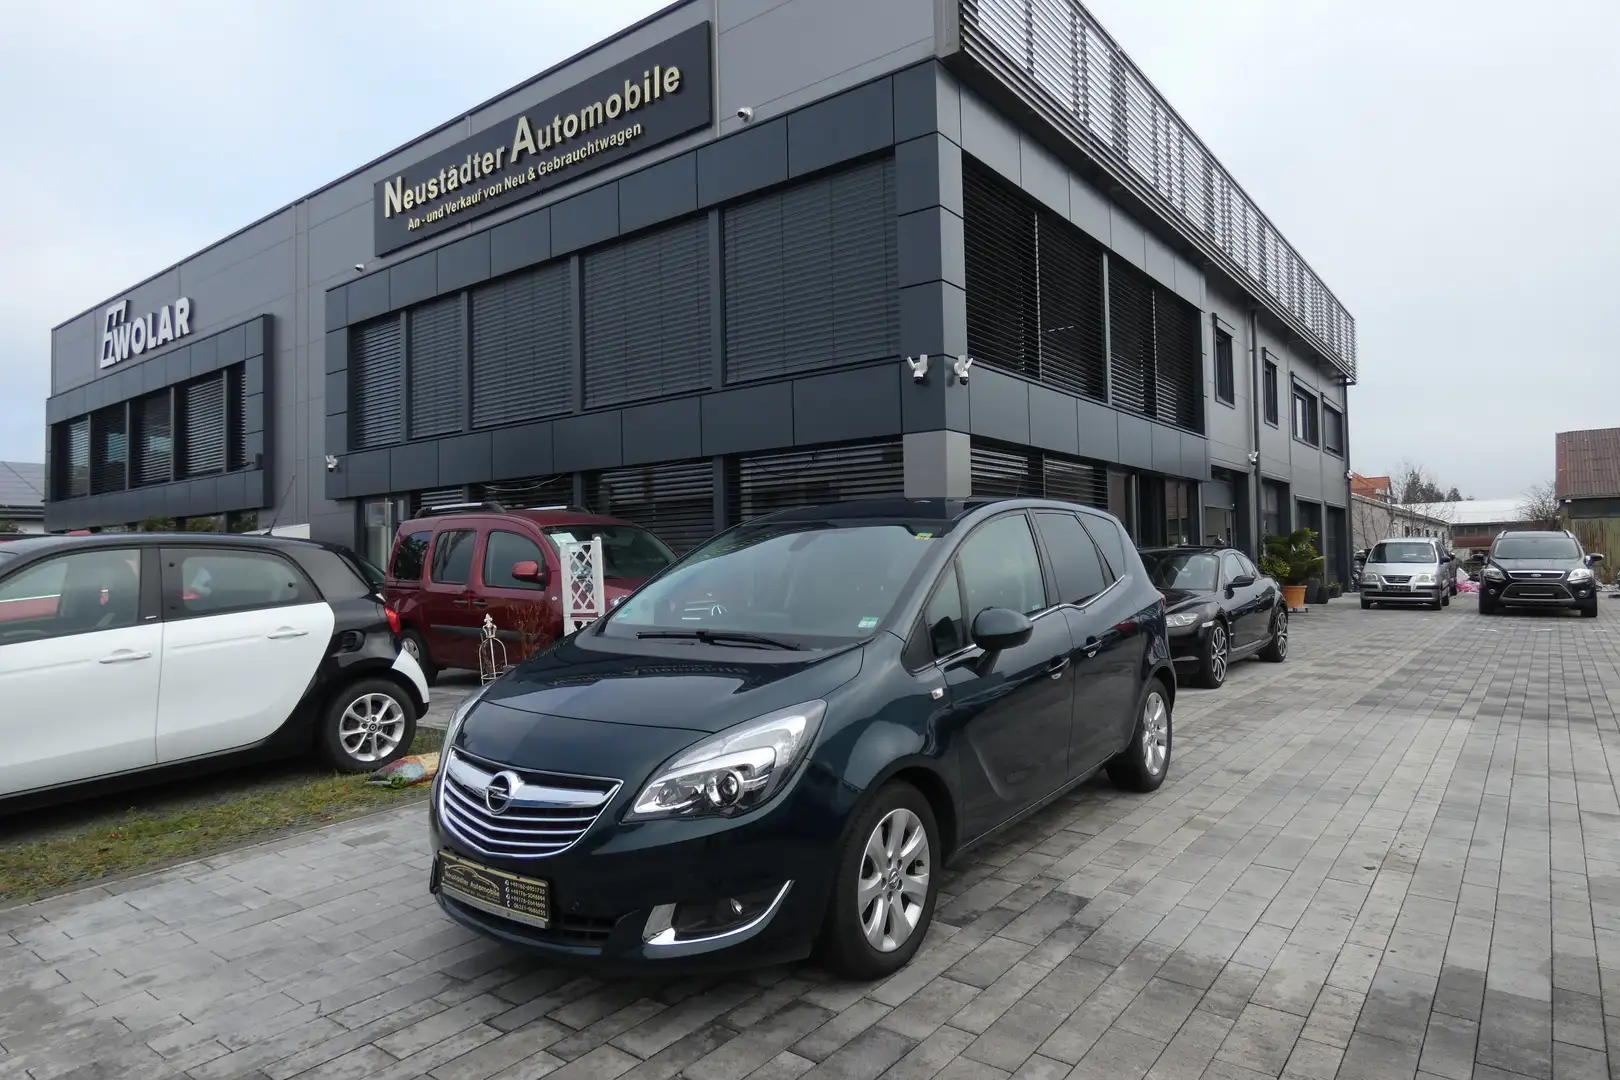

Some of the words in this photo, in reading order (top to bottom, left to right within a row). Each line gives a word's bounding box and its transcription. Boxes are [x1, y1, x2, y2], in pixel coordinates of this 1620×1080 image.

[385, 146, 505, 218] Neustädter
[511, 65, 680, 163] Automobile
[445, 188, 482, 215] Verkauf
[483, 182, 502, 199] von
[504, 173, 525, 190] Neu
[527, 166, 536, 181] &
[538, 123, 641, 176] Gebrauchtwagen
